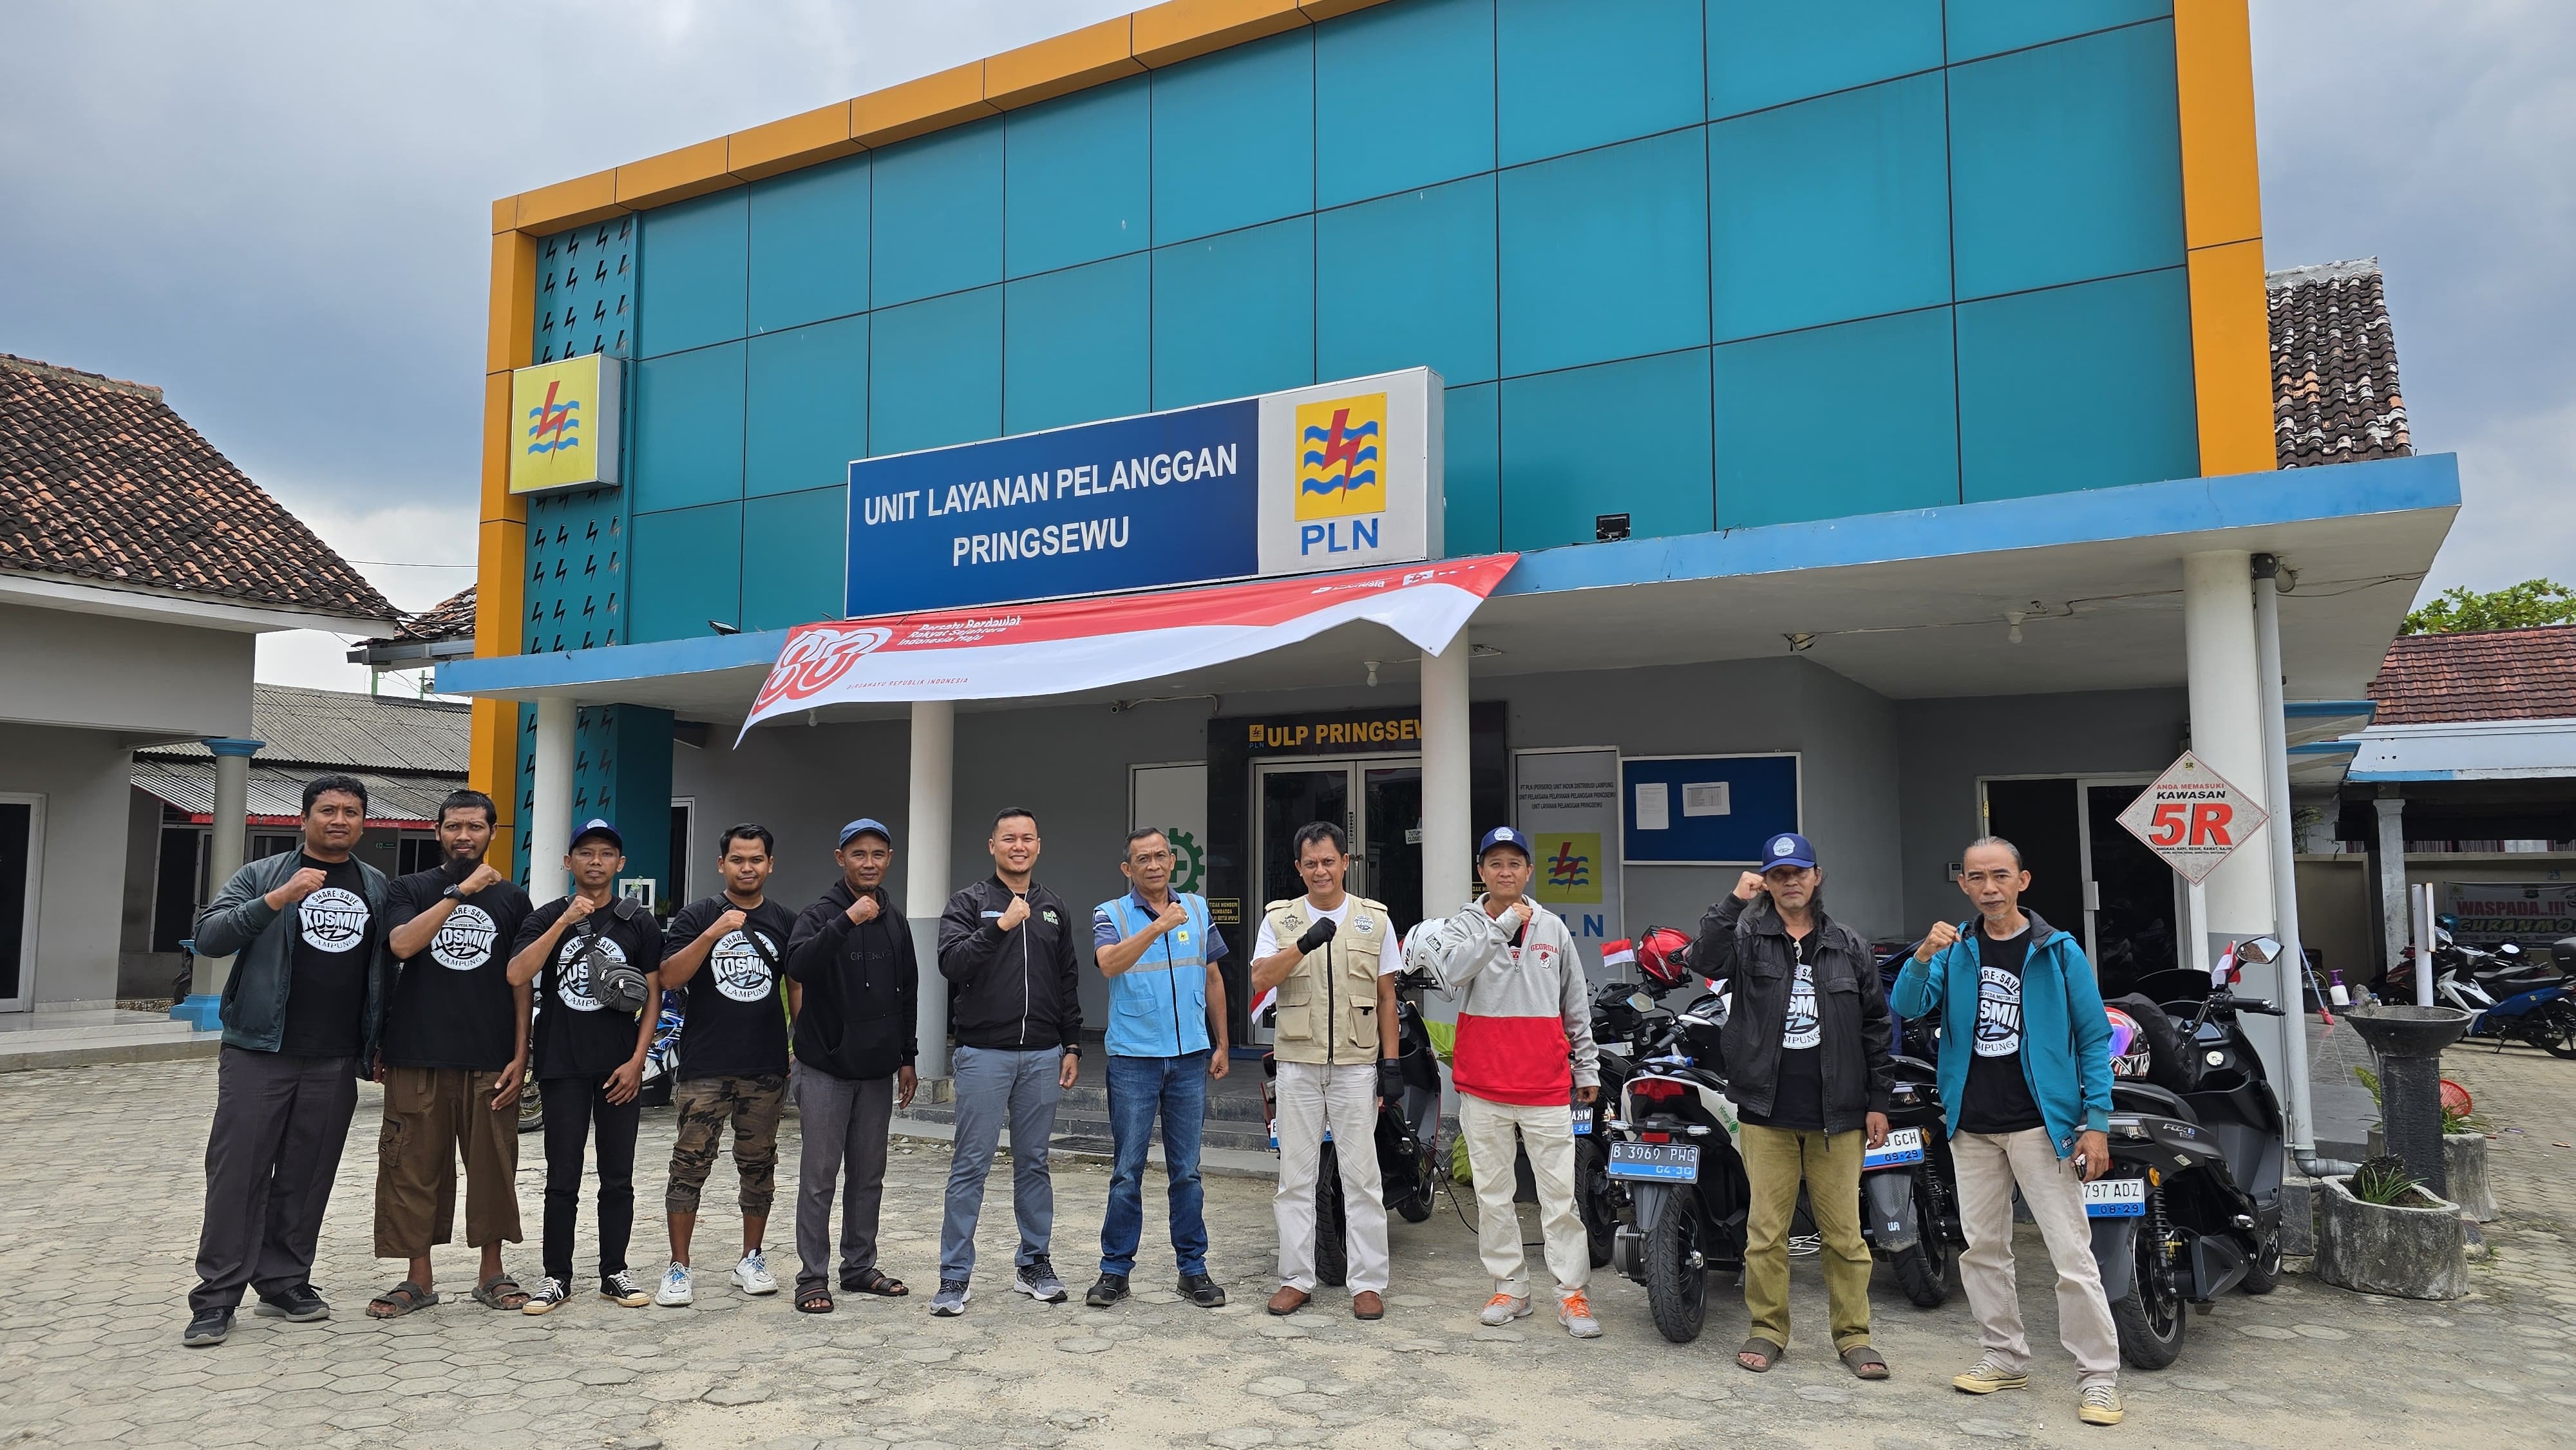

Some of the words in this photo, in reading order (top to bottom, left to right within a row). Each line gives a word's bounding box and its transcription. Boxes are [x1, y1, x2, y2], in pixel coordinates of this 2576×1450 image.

[865, 491, 920, 525] UNIT
[929, 472, 1048, 516] LAYANAN
[1056, 443, 1236, 499] PELANGGAN
[953, 516, 1129, 567] PRINGSEWU
[1302, 518, 1378, 556] PLN
[964, 615, 1021, 629] Berdaulat
[897, 636, 954, 646] Indonesia
[954, 634, 984, 643] Maju
[907, 630, 949, 639] Rakyat
[1267, 726, 1309, 747] ULP
[2157, 791, 2226, 799] KAWASAN
[2148, 803, 2233, 846] 5R
[298, 908, 371, 936] KOSMIK
[1560, 914, 1604, 937] LN
[308, 935, 355, 948] LAMPUNG
[1531, 943, 1559, 954] GEORGIA
[439, 954, 482, 967] LAMPUNG
[724, 984, 769, 997] LAMPUNG
[564, 993, 599, 1006] LAMPU
[1893, 1131, 1917, 1146] GCH
[1613, 1146, 1621, 1158] B
[1627, 1146, 1660, 1160] 3969
[1670, 1148, 1696, 1162] PWG
[2114, 1183, 2140, 1198] ADZ
